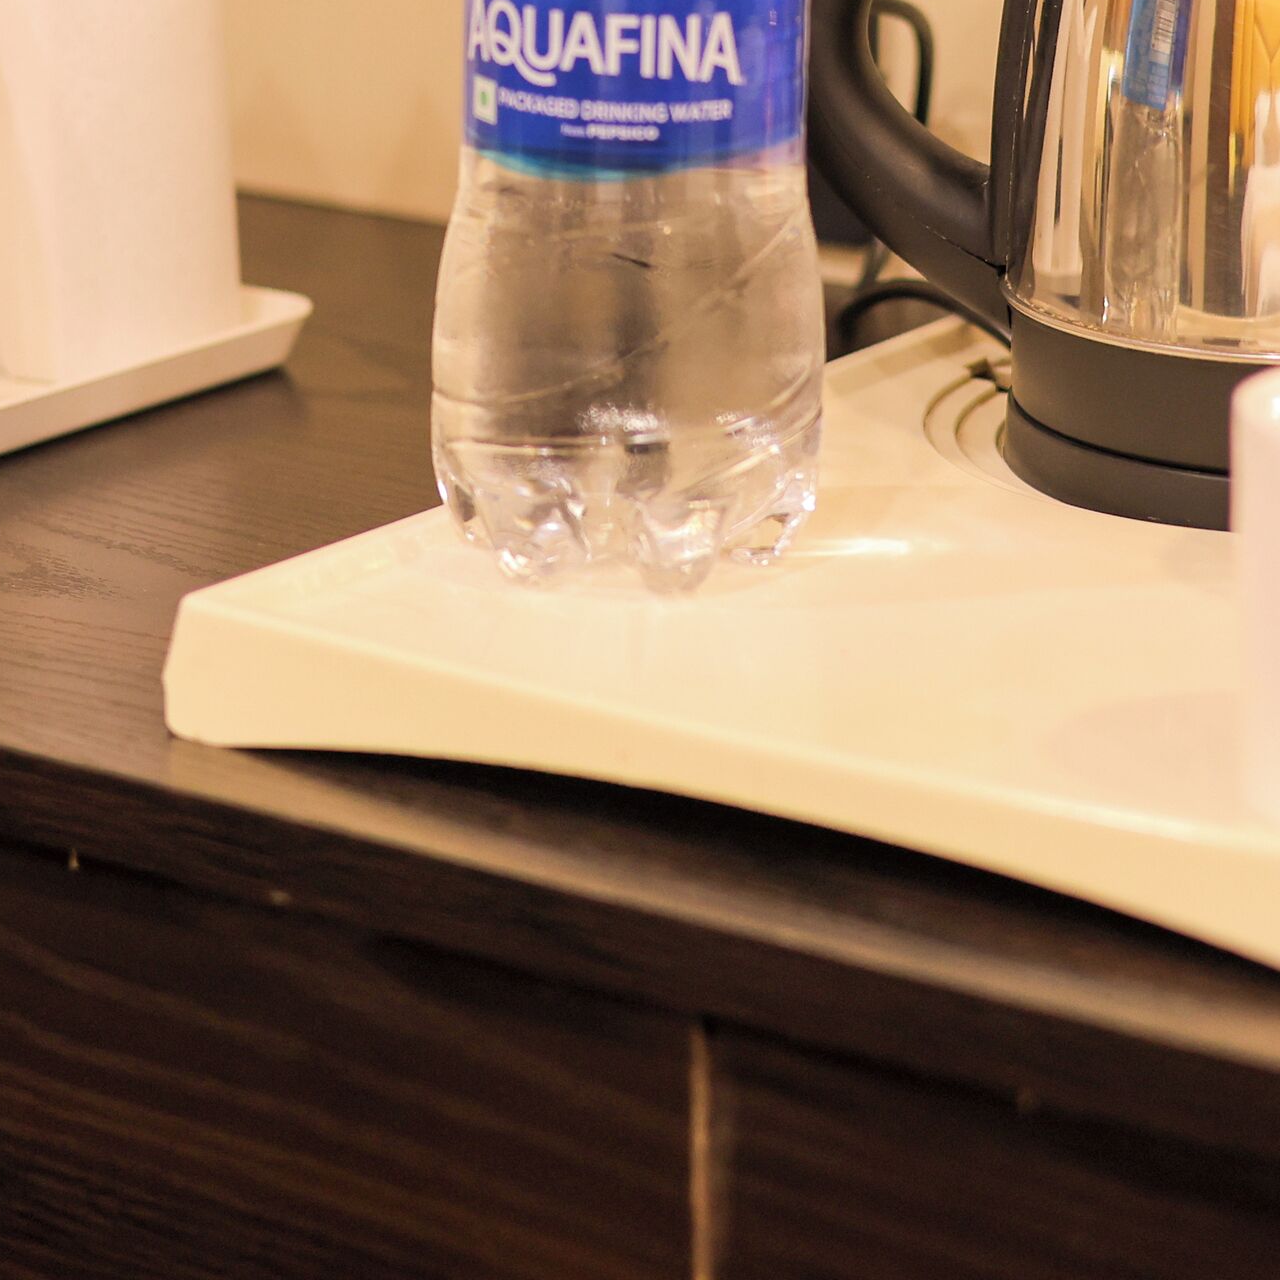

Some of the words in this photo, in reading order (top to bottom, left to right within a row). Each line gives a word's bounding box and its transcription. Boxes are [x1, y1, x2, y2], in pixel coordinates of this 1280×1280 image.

[498, 87, 579, 120] PACKAGED
[580, 98, 669, 123] DRINKING
[670, 97, 734, 122] WATER
